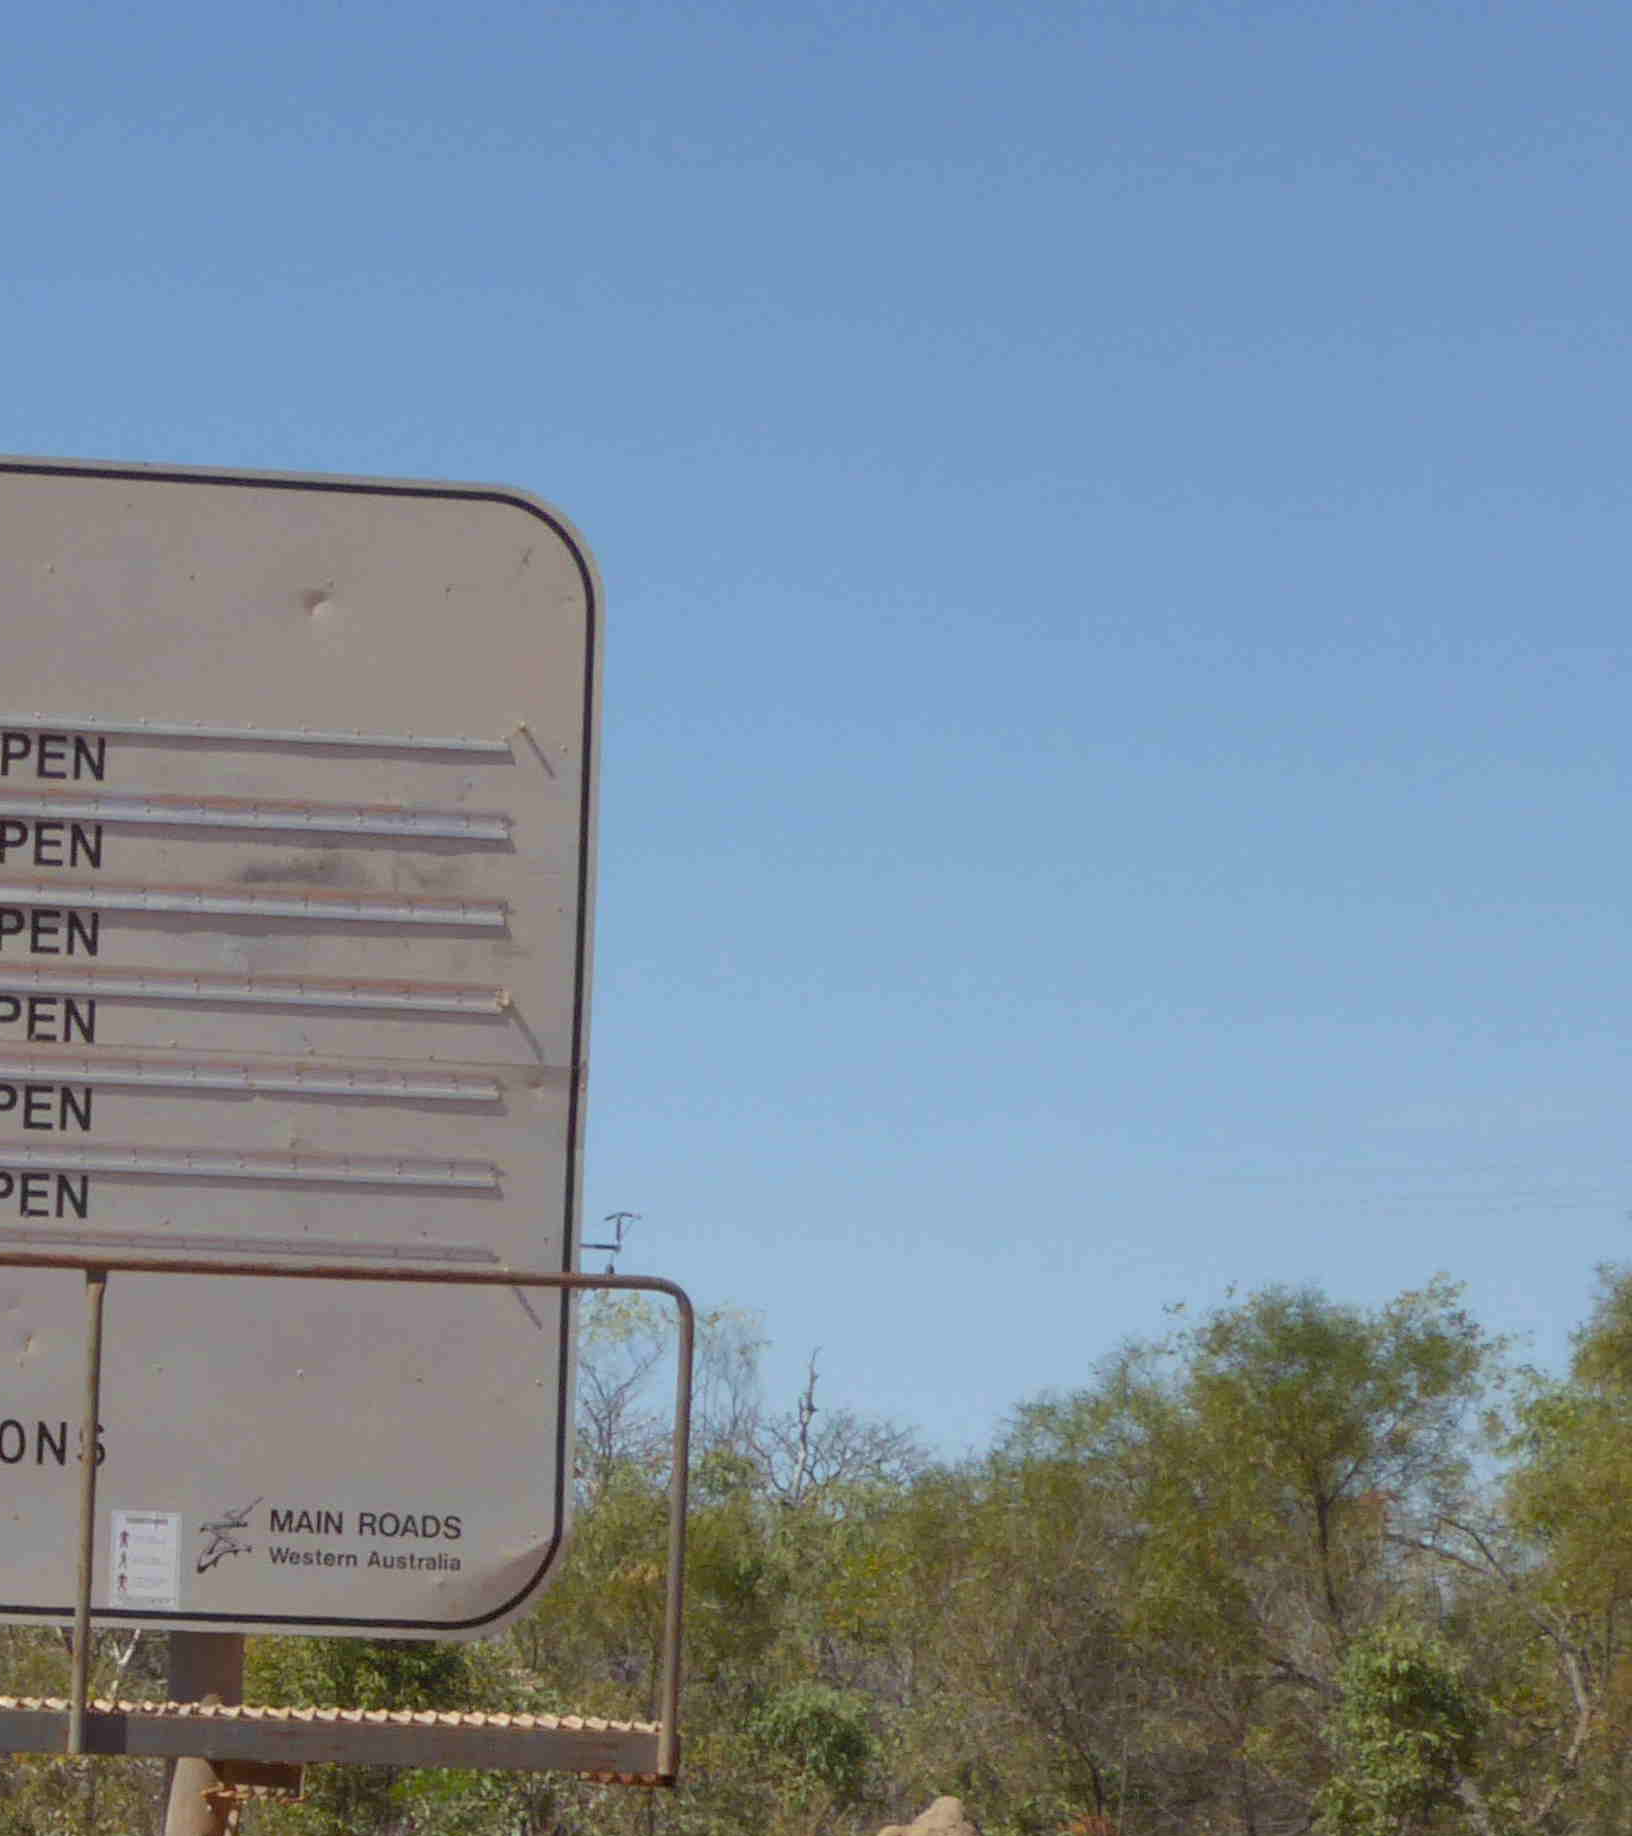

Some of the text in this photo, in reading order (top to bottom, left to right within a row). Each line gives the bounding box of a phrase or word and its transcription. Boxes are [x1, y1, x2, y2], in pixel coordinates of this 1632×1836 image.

[269, 1508, 463, 1540] MAIN ROADS
[269, 1546, 462, 1572] Western Australia
